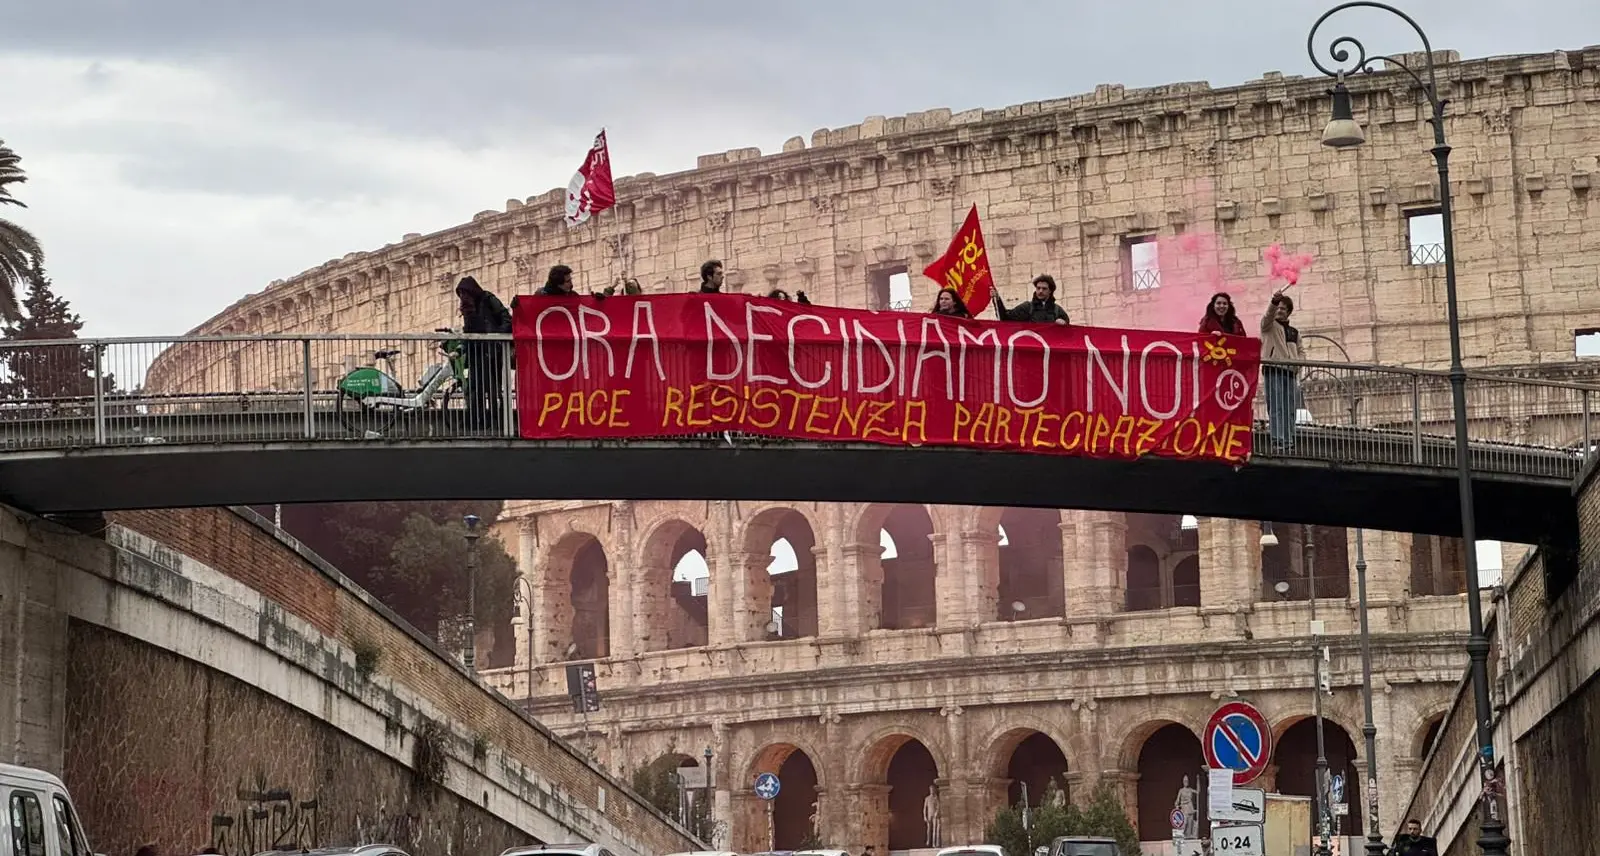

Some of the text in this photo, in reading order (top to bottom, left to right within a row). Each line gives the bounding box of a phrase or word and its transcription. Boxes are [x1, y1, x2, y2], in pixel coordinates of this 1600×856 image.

[535, 300, 1200, 420] ORA DECIDIAMO NOI
[537, 388, 631, 429] PACE
[662, 383, 928, 442] RESISTENZA
[1221, 836, 1251, 850] 0-24
